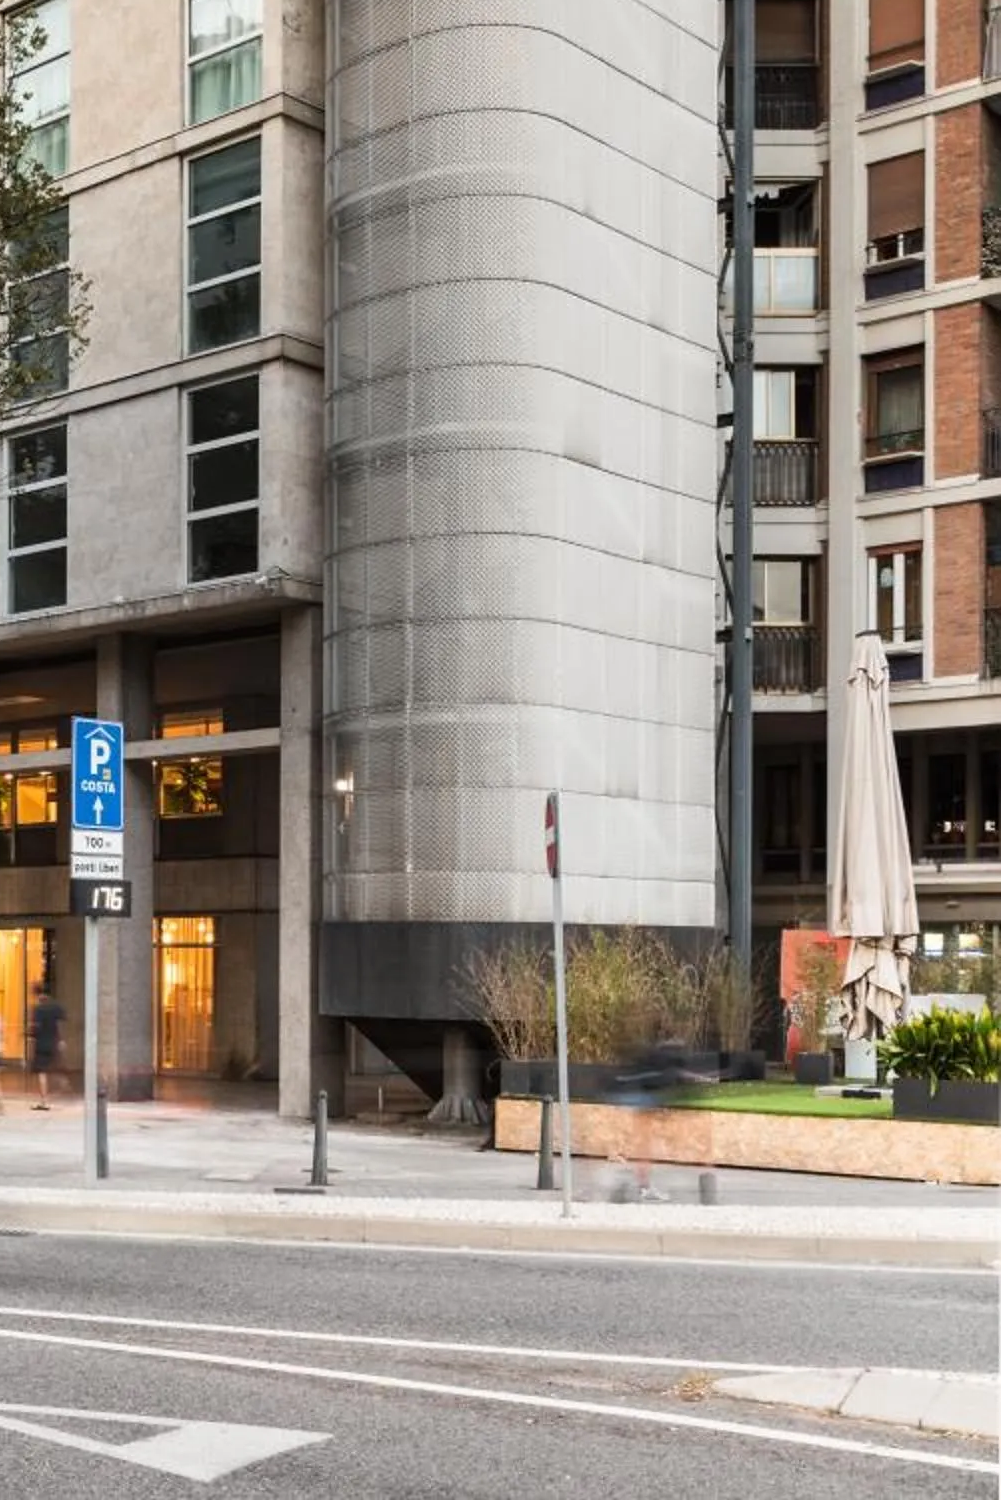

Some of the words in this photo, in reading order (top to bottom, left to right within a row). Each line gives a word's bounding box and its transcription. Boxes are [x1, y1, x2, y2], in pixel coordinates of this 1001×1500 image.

[90, 739, 111, 775] P
[80, 779, 116, 795] COSTA
[92, 886, 123, 911] 176
